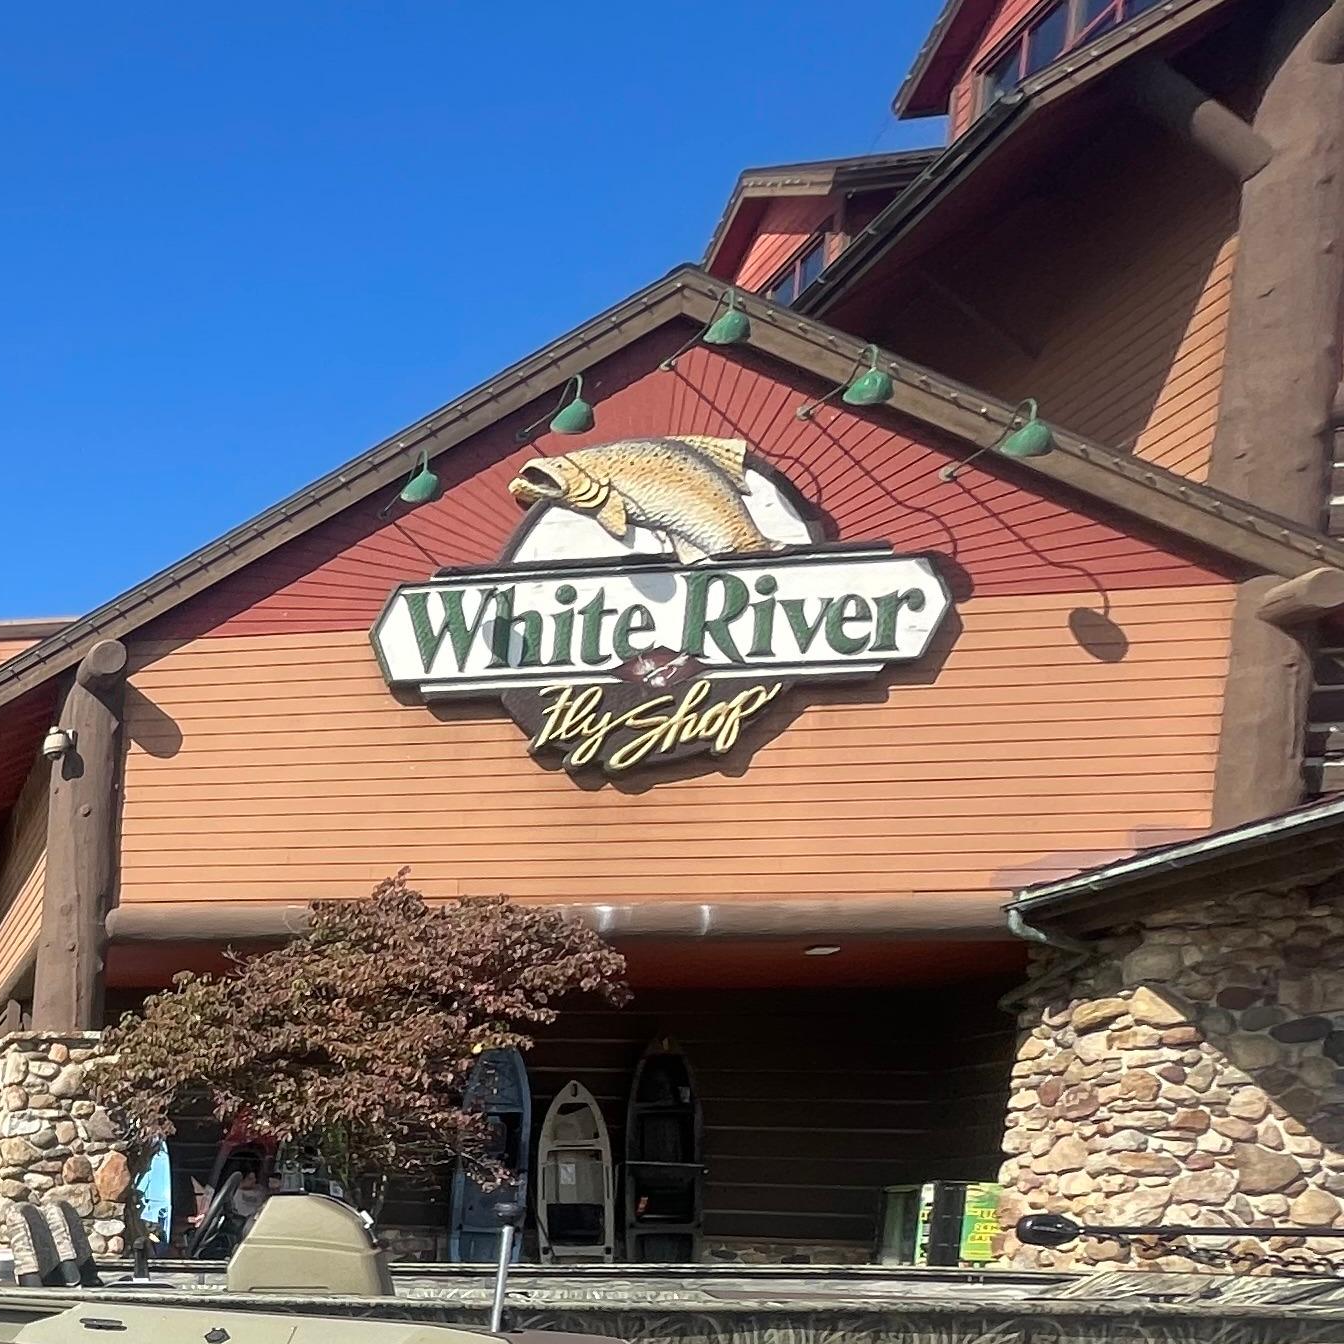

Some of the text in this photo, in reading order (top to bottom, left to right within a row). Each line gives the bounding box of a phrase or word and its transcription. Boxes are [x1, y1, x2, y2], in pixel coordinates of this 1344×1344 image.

[399, 569, 926, 674] White River
[535, 679, 783, 771] Fly Shop
